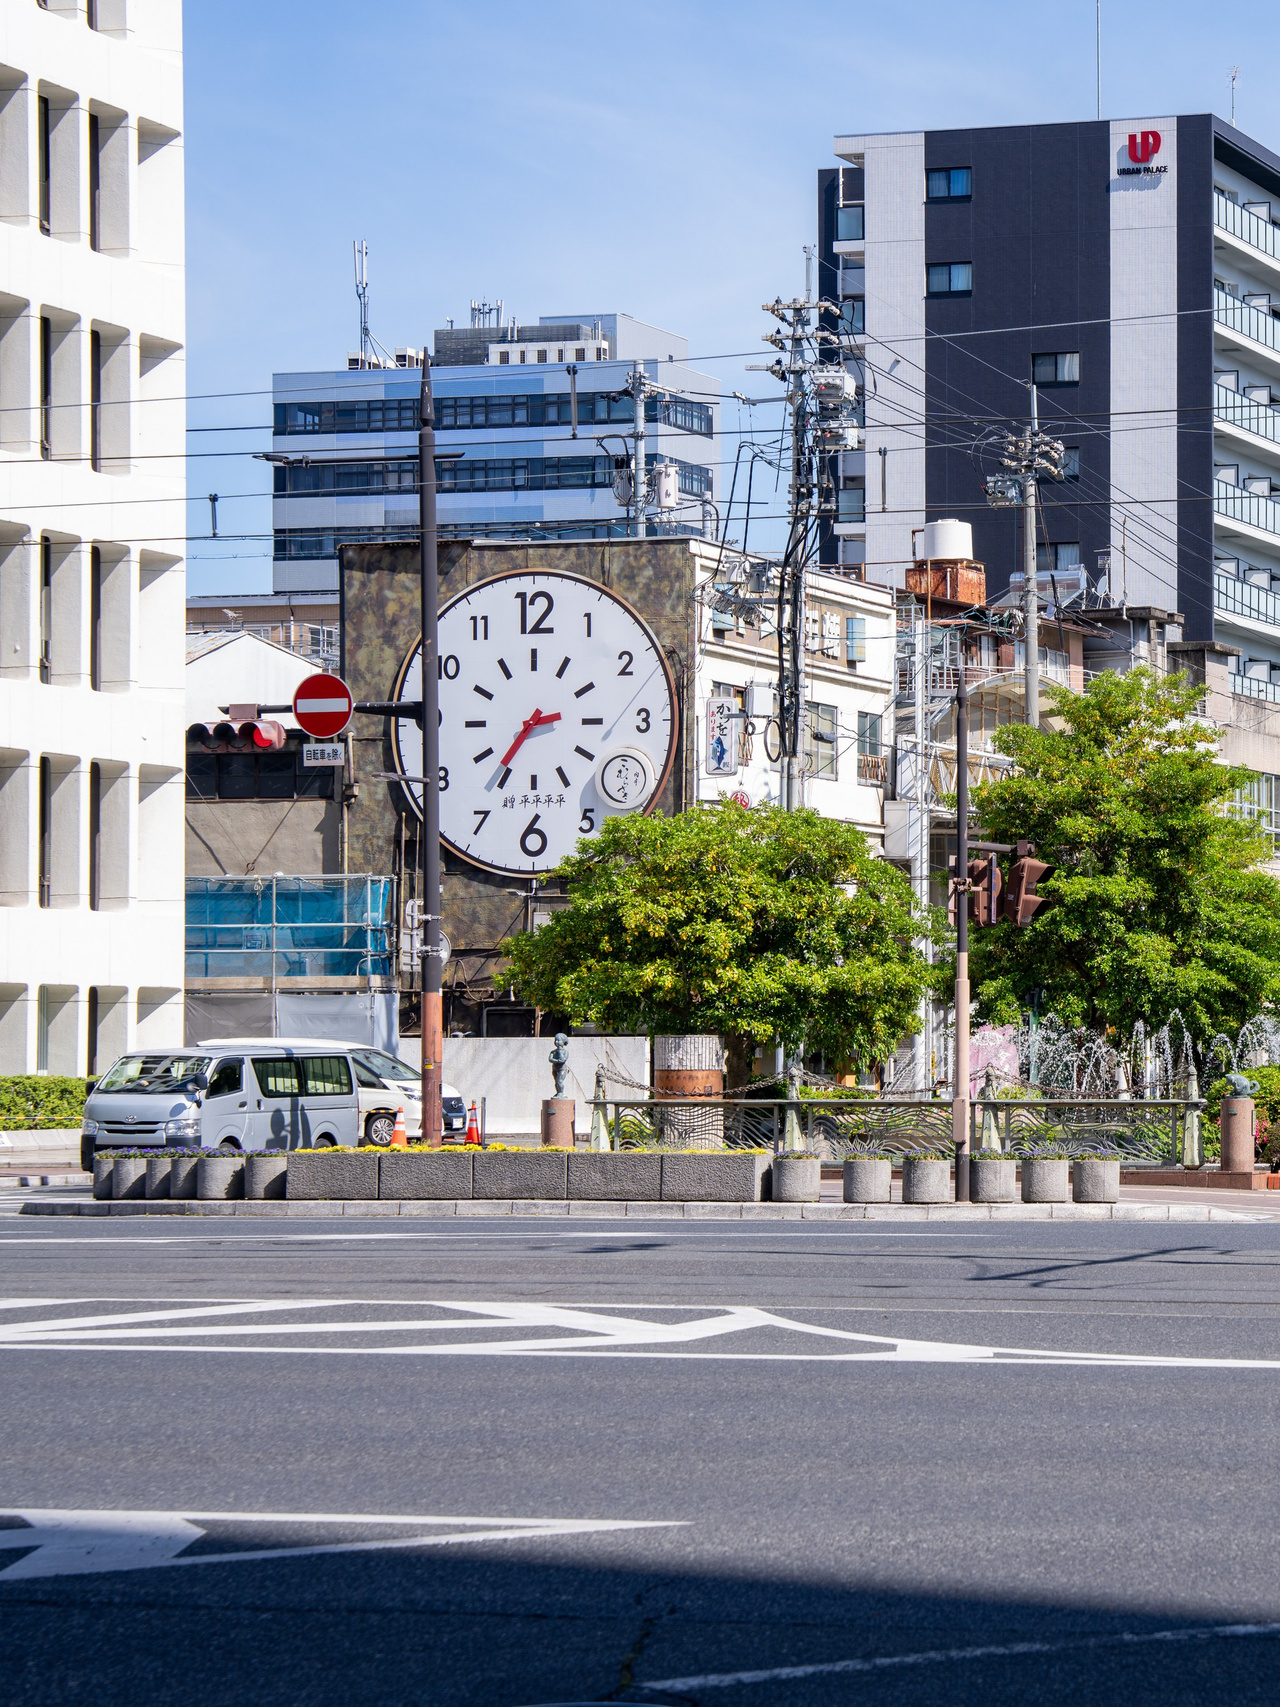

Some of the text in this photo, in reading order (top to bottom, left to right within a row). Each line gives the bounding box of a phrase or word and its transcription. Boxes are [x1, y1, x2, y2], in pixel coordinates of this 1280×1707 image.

[1128, 130, 1161, 163] UP
[1117, 165, 1168, 176] URBAN PALACE
[514, 591, 554, 634] 12
[583, 612, 592, 638] 1
[469, 615, 489, 640] 11
[617, 651, 634, 676] 2
[636, 708, 651, 733] 3
[306, 748, 342, 761] 自転車を除く
[473, 810, 491, 836] 7
[578, 808, 595, 834] 5
[520, 813, 548, 857] 6
